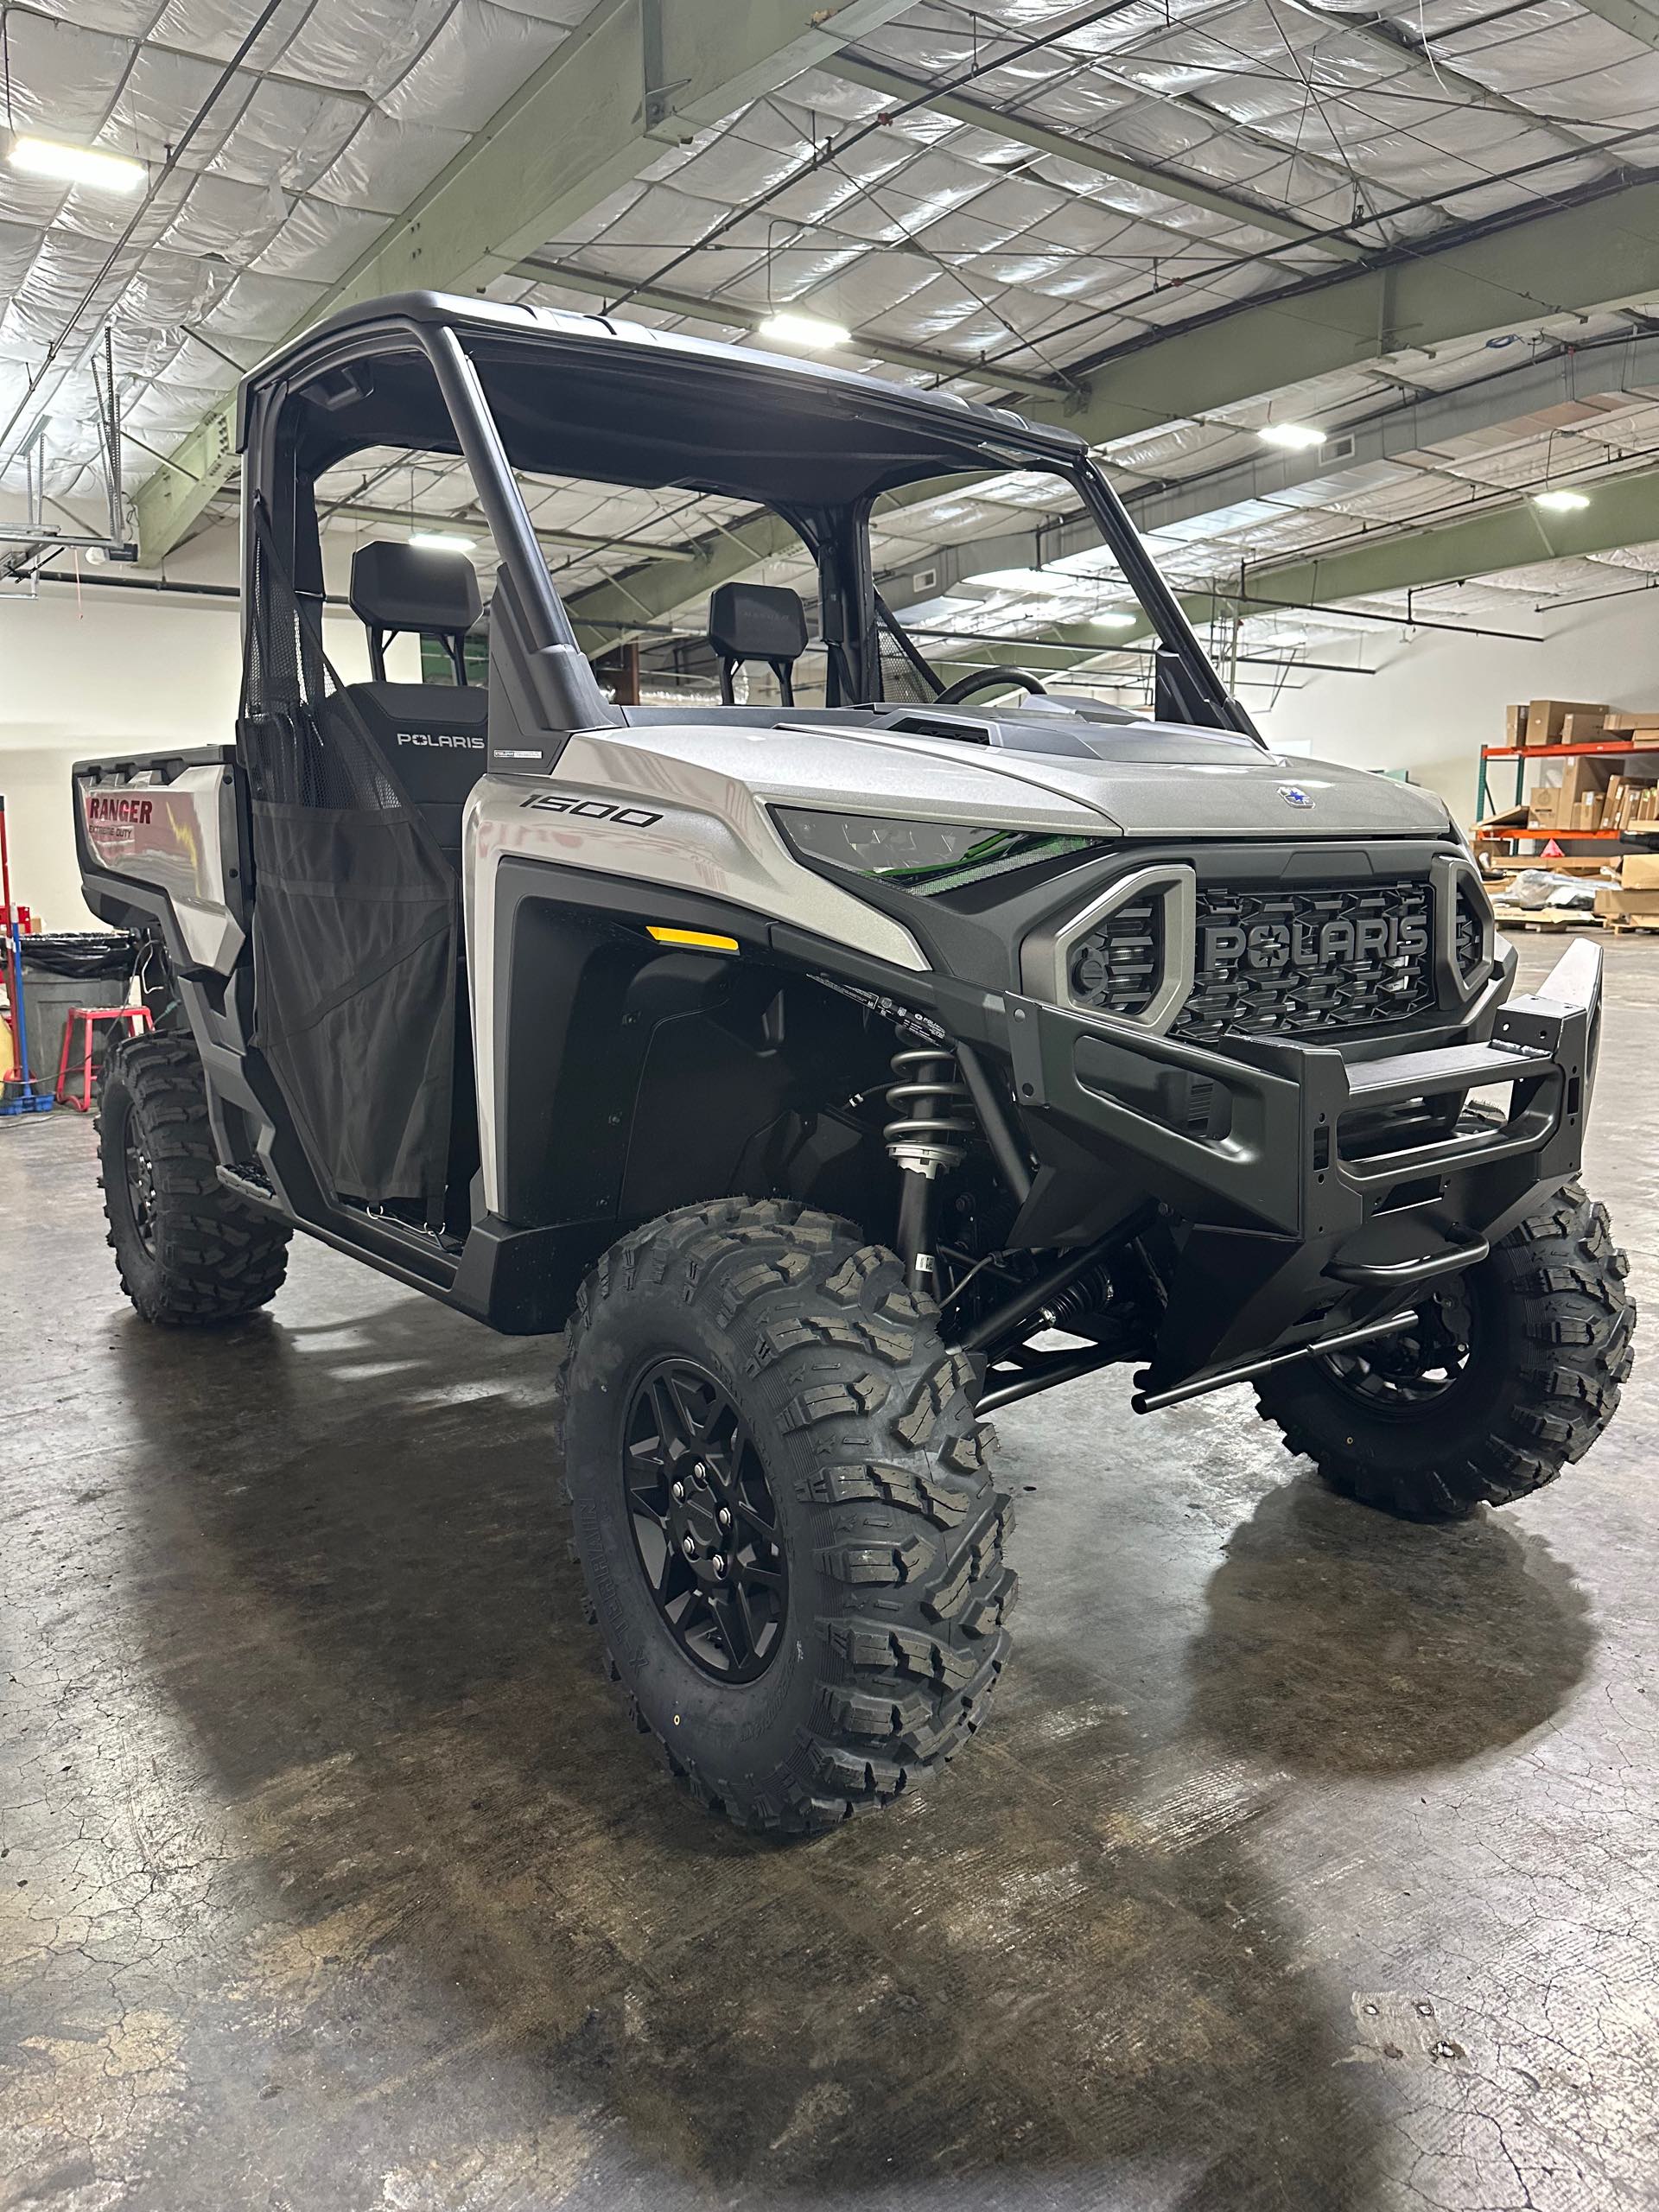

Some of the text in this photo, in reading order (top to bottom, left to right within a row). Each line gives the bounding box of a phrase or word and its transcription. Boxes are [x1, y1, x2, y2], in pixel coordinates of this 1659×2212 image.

[397, 732, 486, 749] POLARIS
[91, 798, 153, 824] RANGER
[518, 794, 664, 829] 1500
[117, 829, 132, 838] DUTY
[1204, 915, 1427, 972] POLARIS
